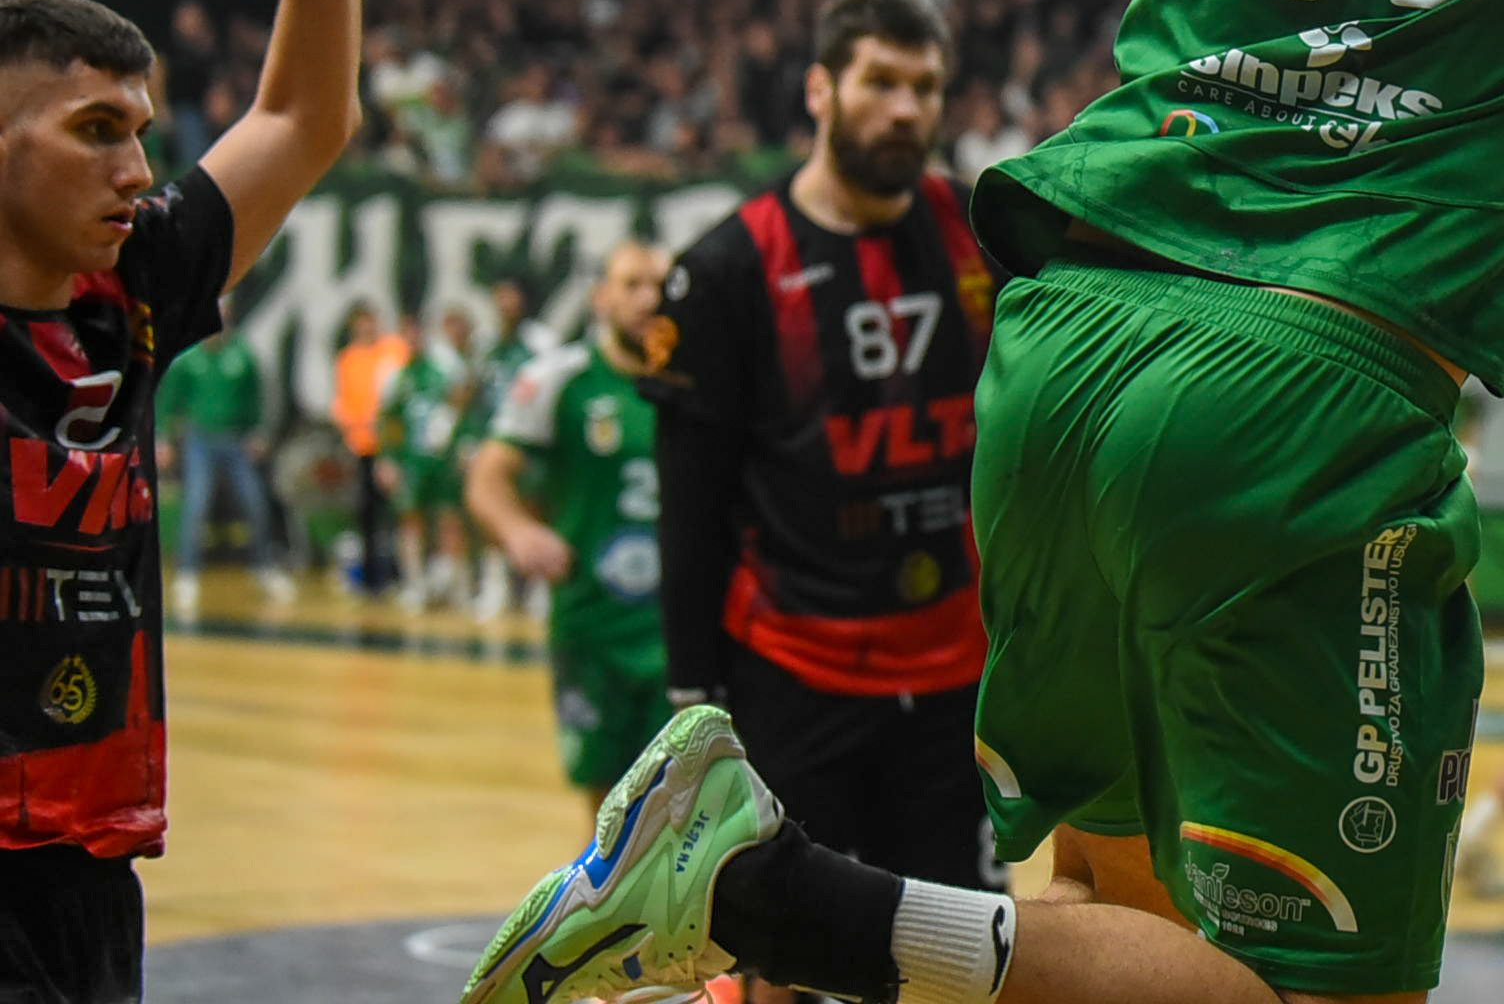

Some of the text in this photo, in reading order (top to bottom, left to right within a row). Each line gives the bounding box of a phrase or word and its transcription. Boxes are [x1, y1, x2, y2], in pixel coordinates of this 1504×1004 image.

[1177, 79, 1234, 105] CARE
[844, 291, 944, 380] 87
[1353, 525, 1405, 784] GP PELISTER
[1387, 576, 1402, 693] GRADEZNISTVO
[1387, 694, 1402, 717] ZA
[1386, 717, 1403, 786] DRUSTVO
[1184, 850, 1305, 922] Jamieson
